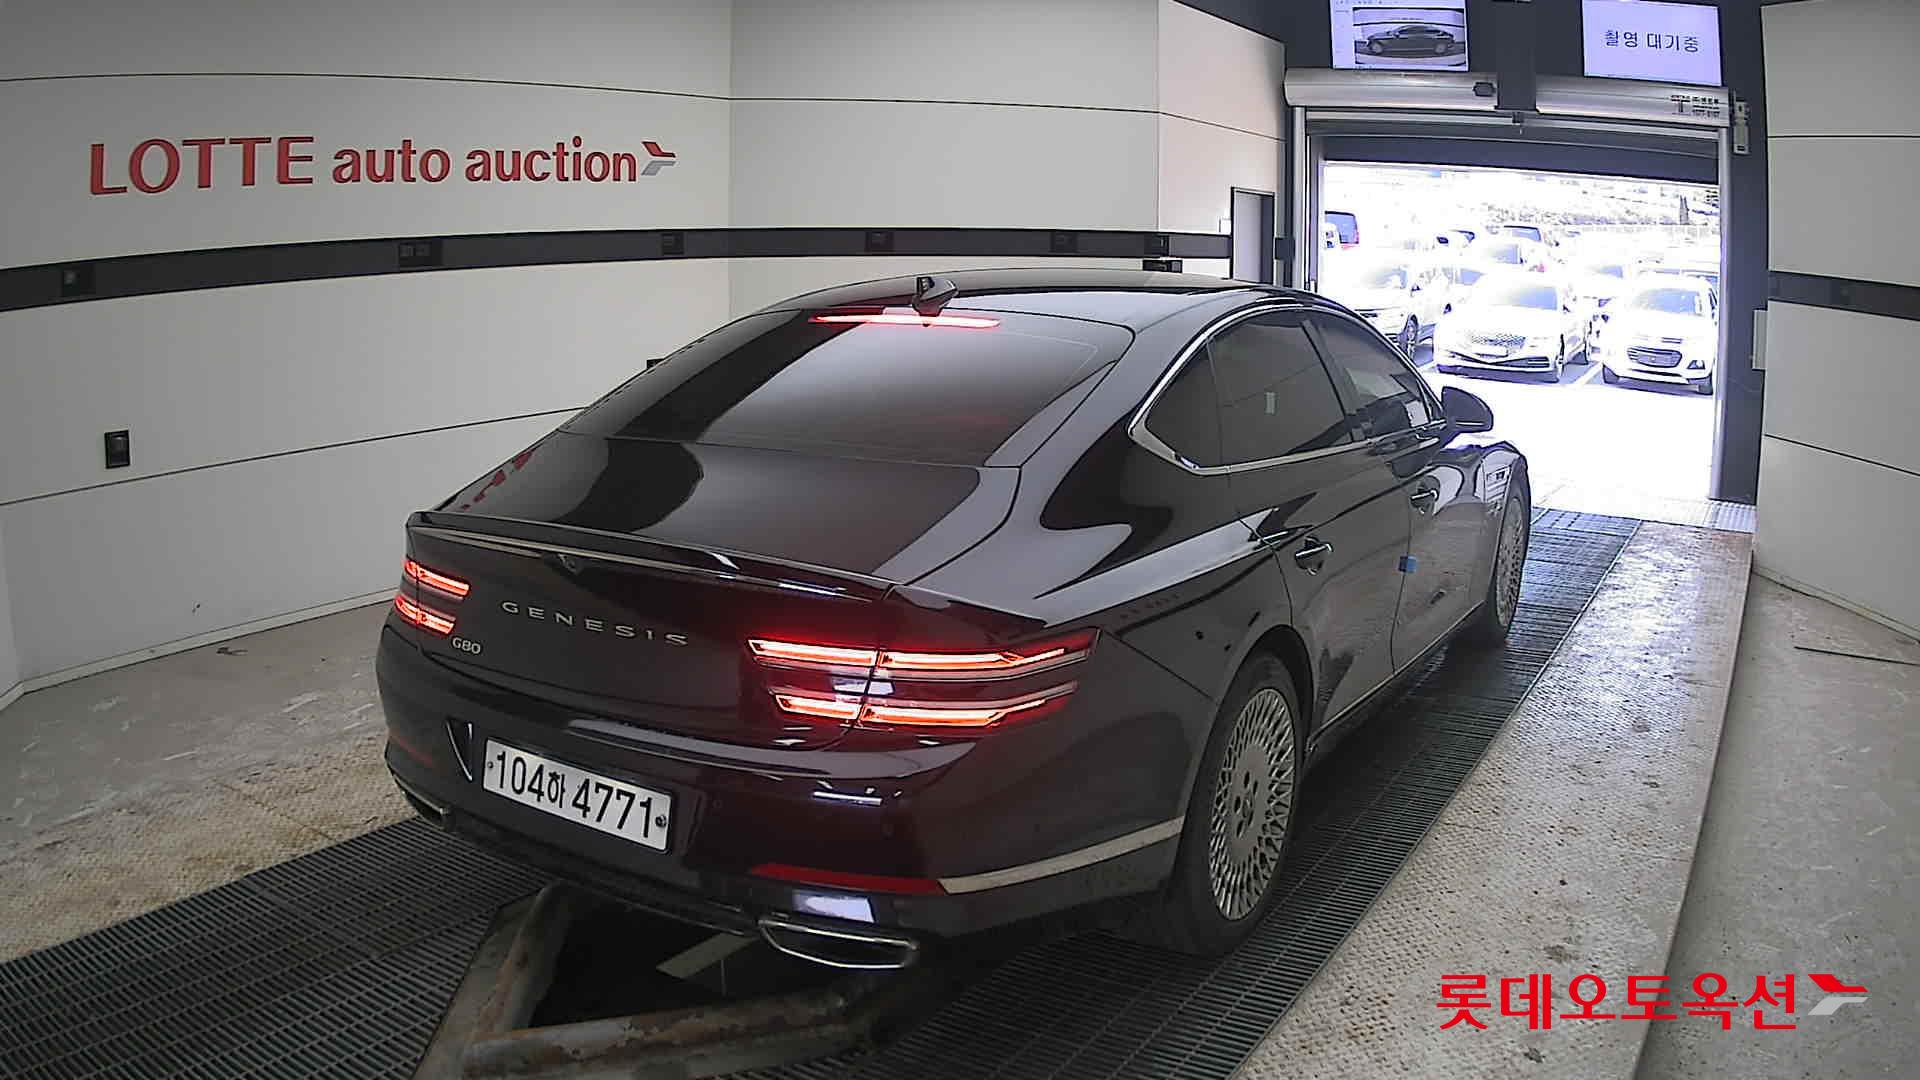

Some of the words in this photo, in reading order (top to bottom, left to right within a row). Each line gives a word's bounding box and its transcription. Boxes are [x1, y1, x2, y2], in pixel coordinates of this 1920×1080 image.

[1647, 33, 1699, 53] 대기중
[90, 136, 314, 195] LOTTE
[333, 139, 451, 184] auto
[465, 136, 638, 184] auction
[452, 637, 481, 655] G80
[501, 600, 690, 646] GENESIS
[571, 777, 653, 839] 4771
